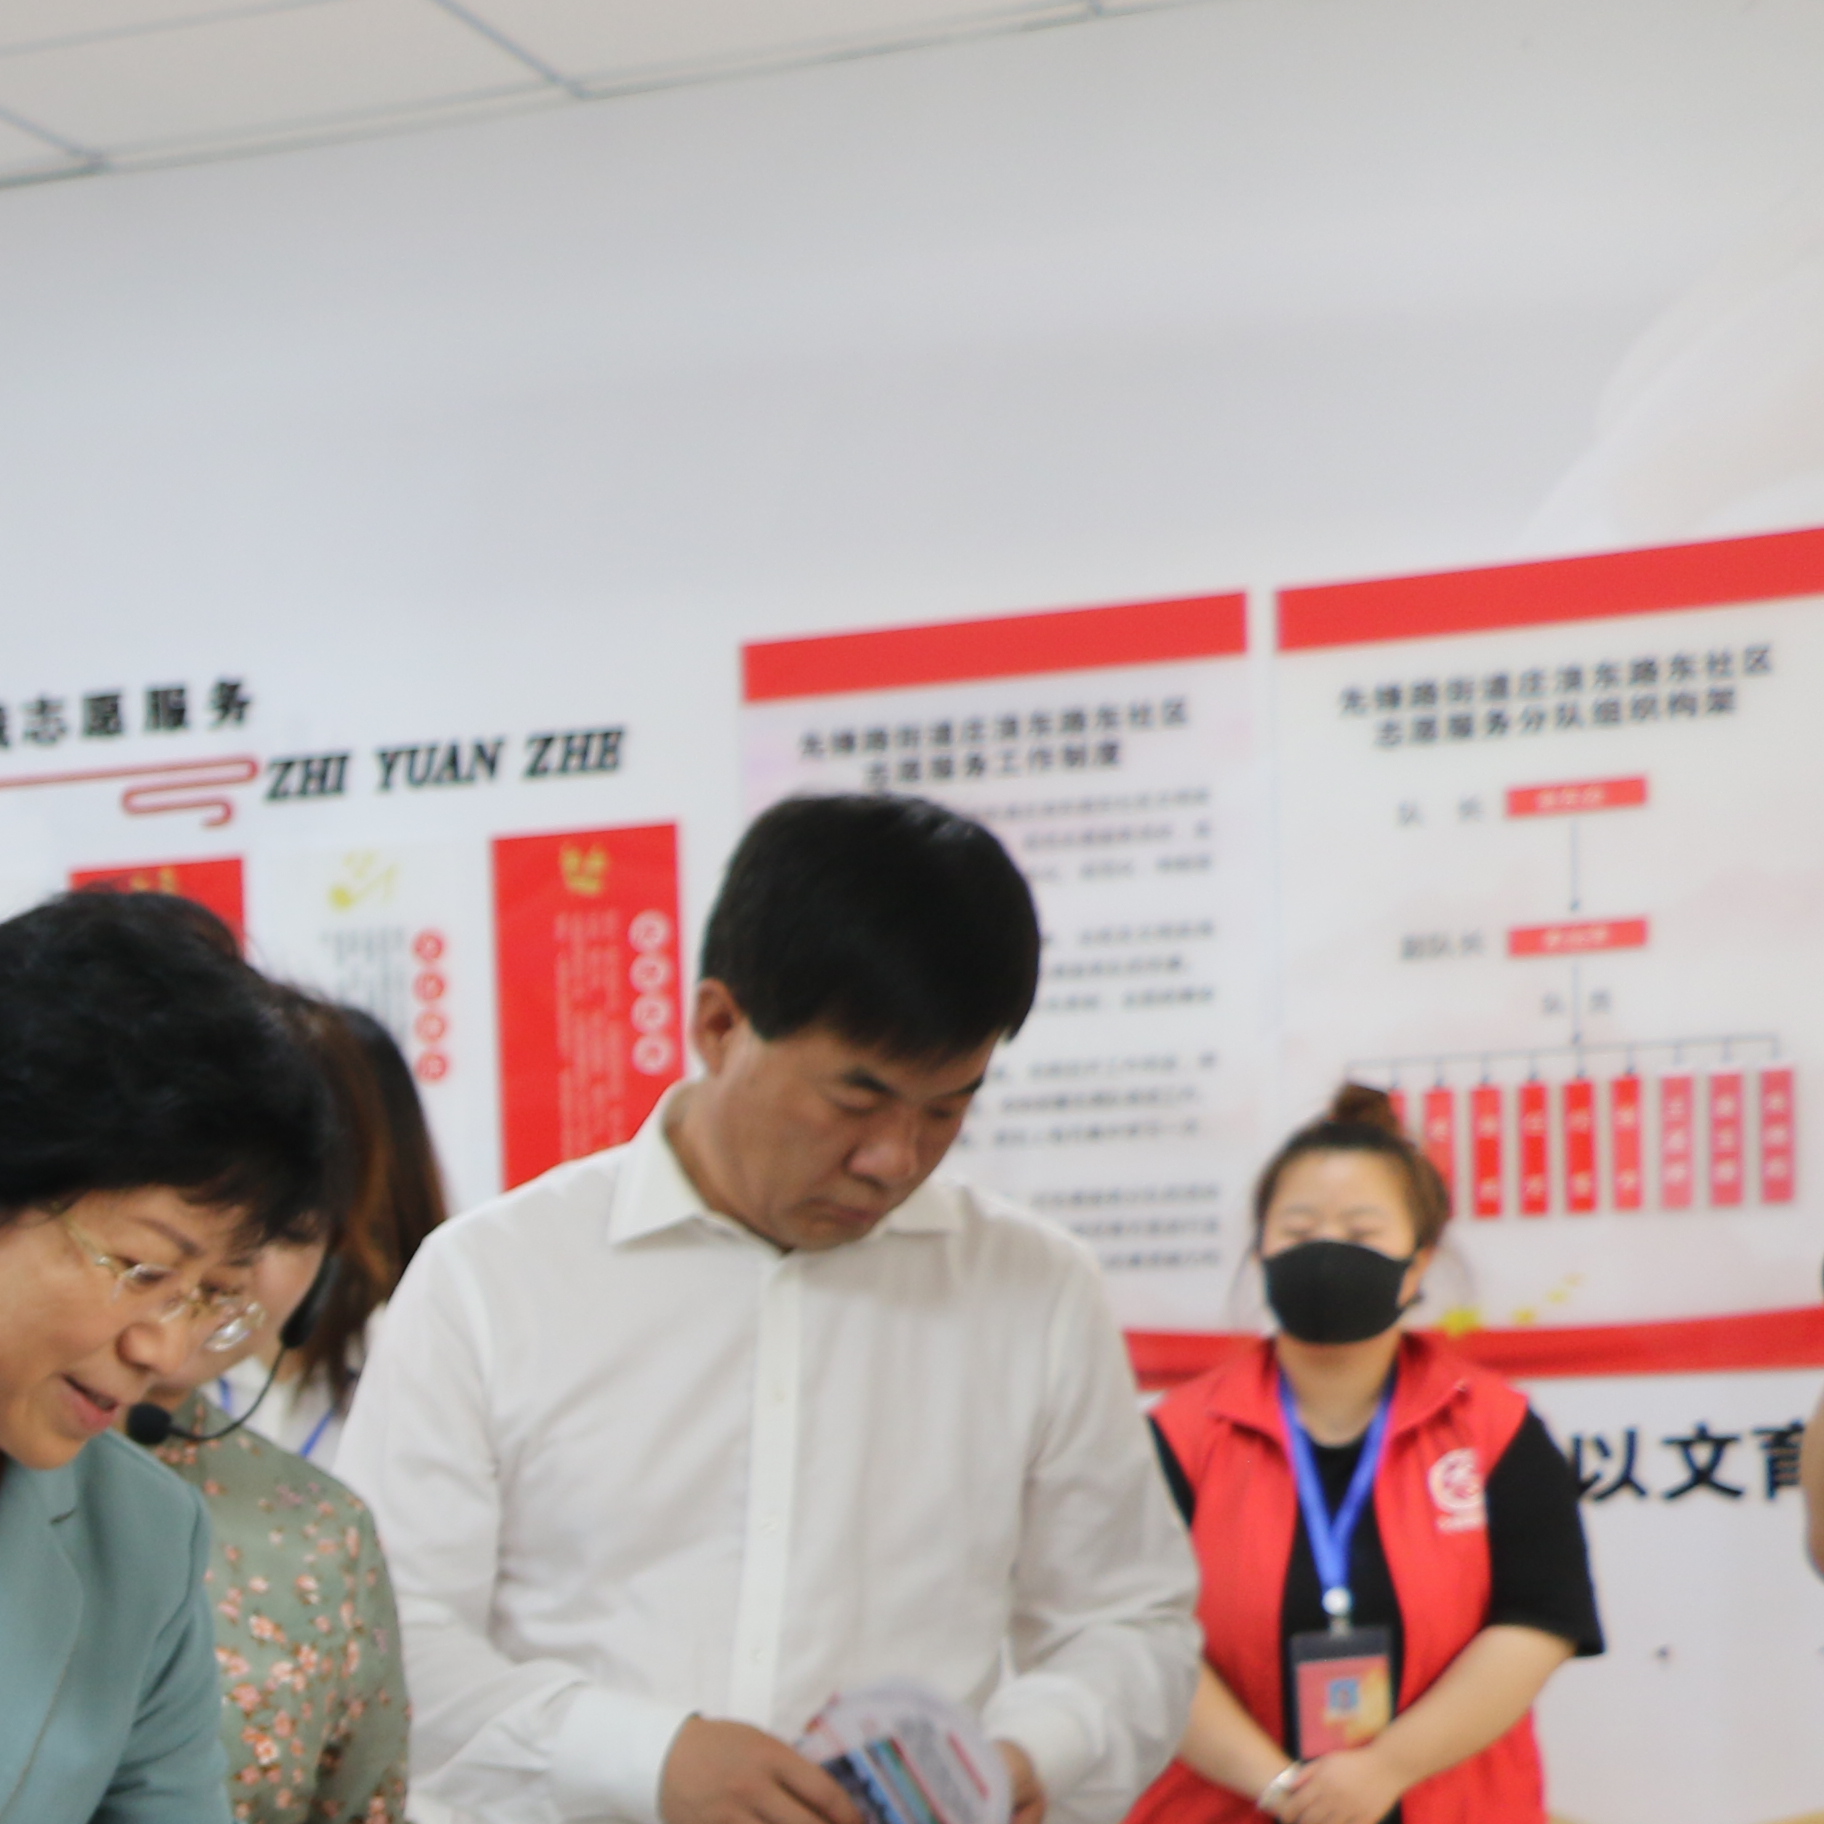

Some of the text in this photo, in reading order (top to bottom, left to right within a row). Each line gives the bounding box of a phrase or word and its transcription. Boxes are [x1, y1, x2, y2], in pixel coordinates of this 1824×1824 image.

[266, 725, 628, 803] ZHI YUAN ZHE
